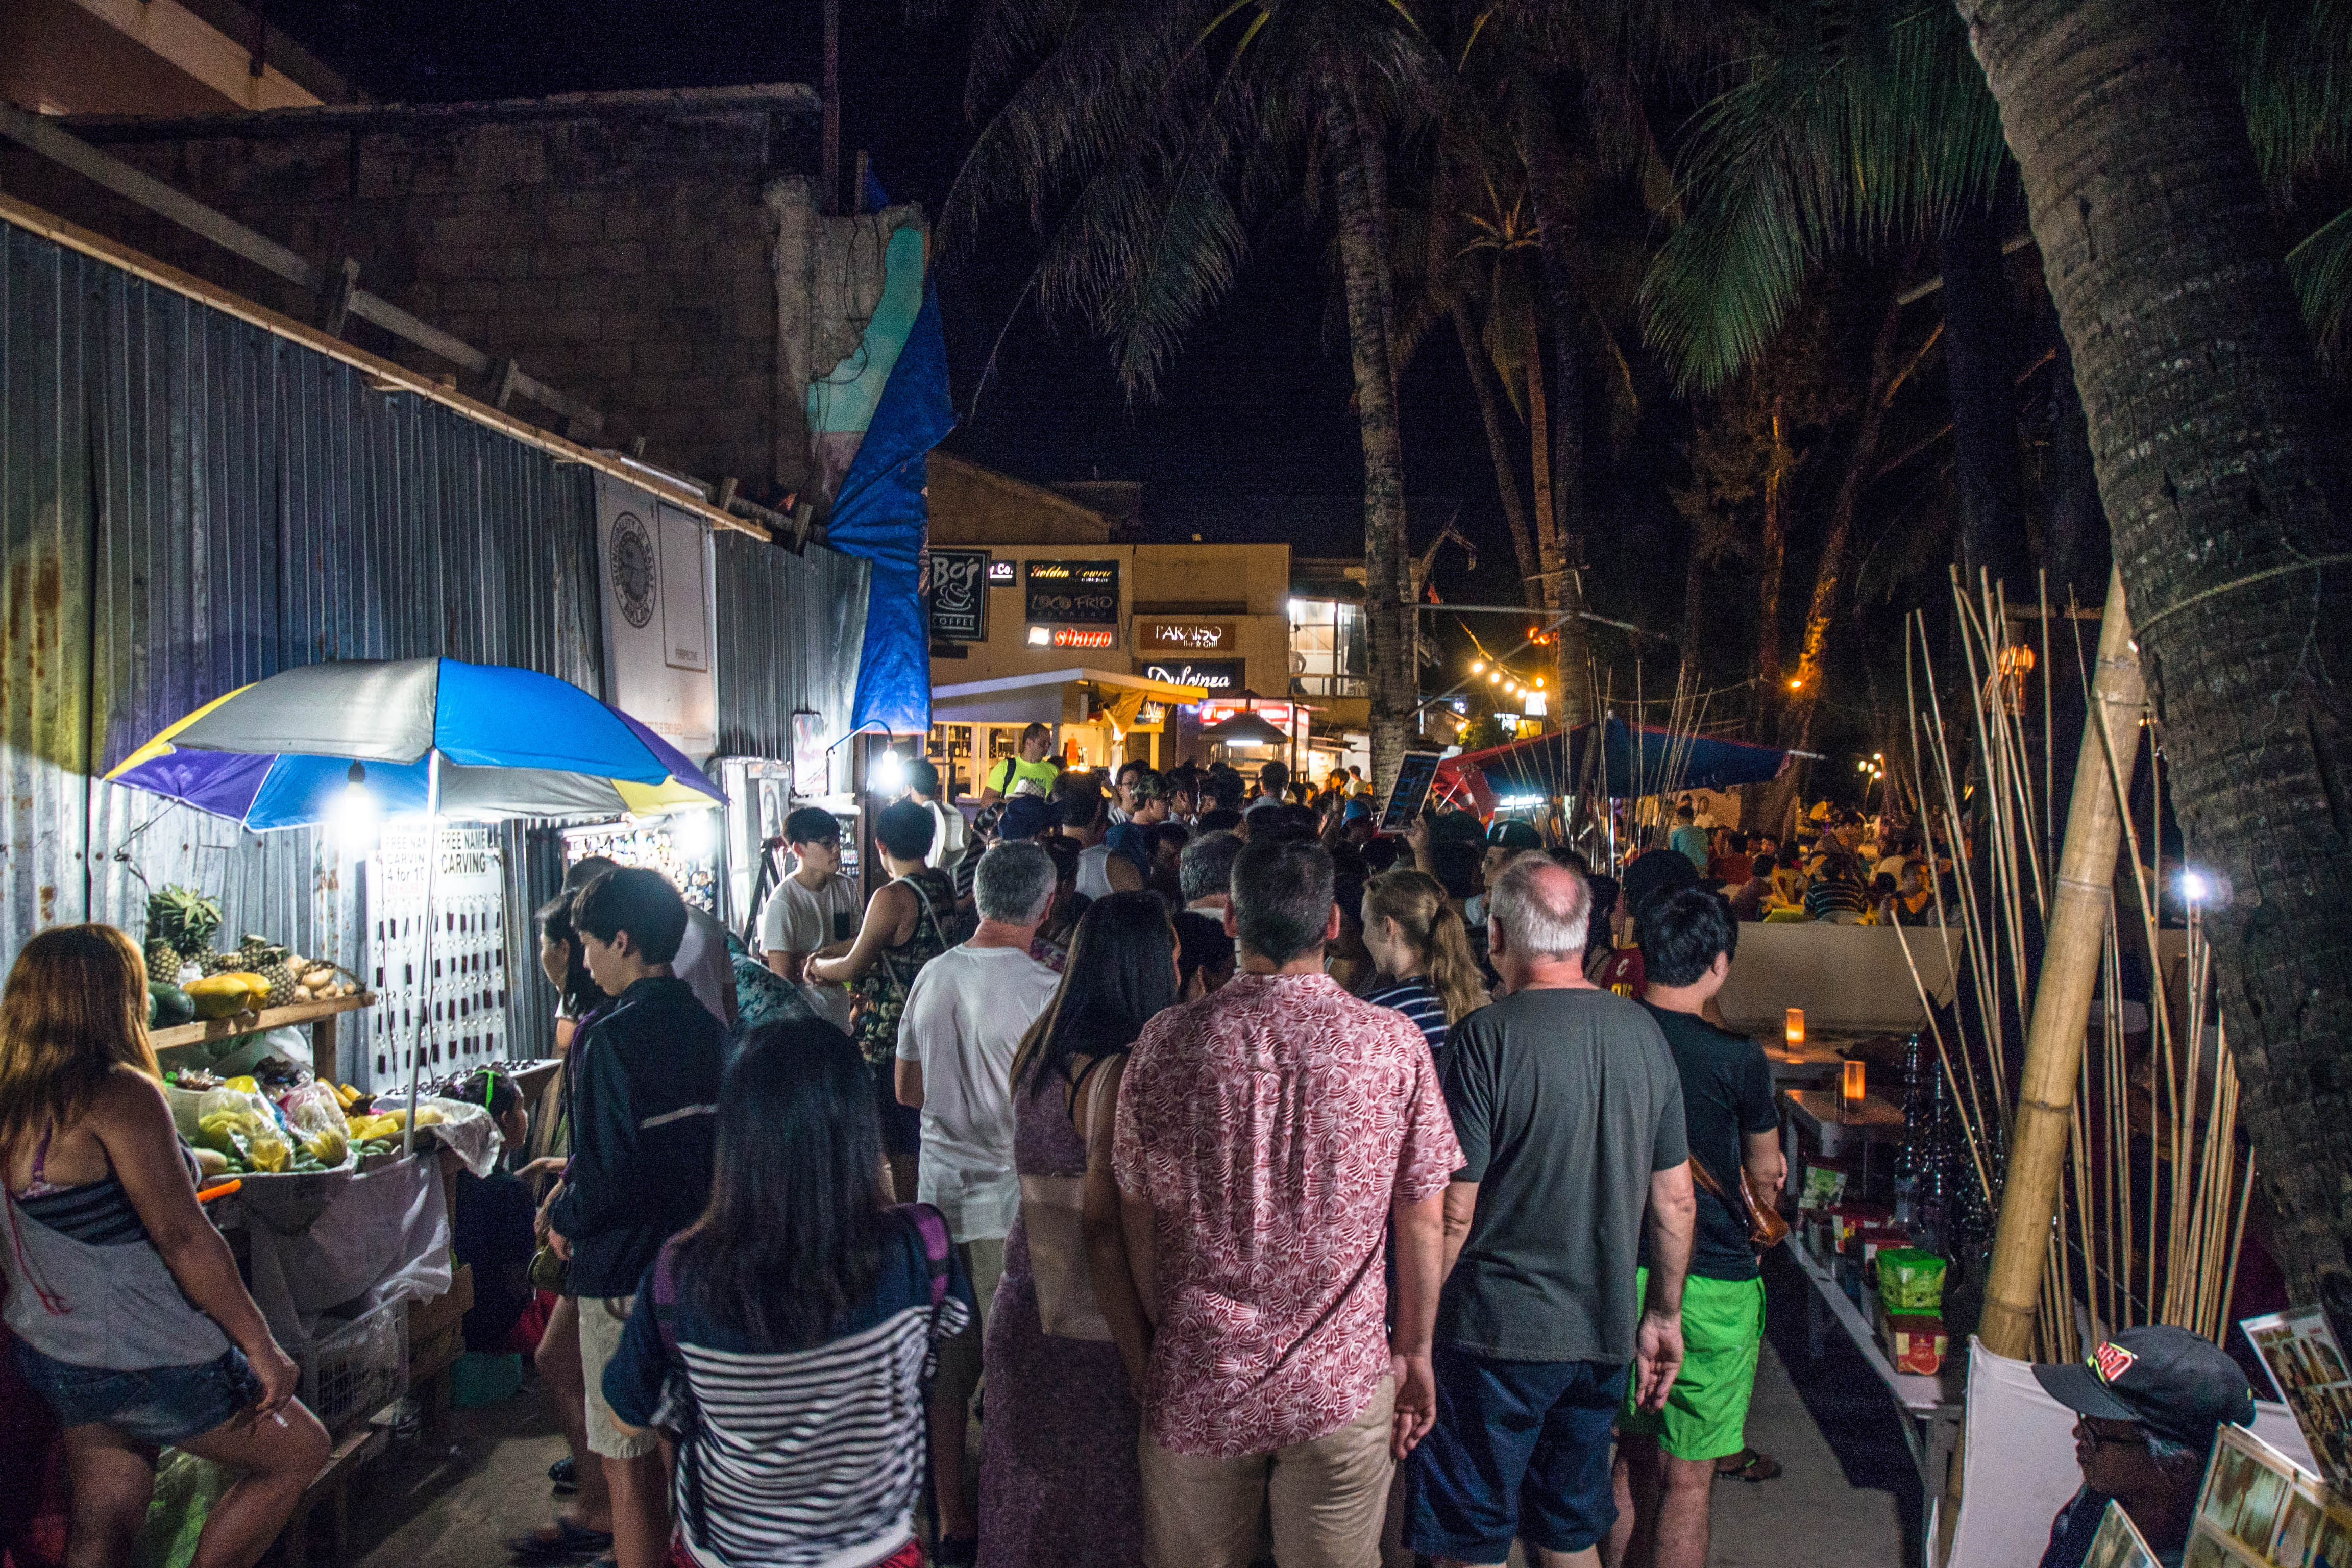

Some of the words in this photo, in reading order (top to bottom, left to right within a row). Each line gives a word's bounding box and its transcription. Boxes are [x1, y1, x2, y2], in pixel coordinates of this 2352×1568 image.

[1074, 594, 1113, 609] FRIO
[932, 617, 974, 626] COFFEE
[1055, 627, 1112, 647] sbarro
[441, 831, 461, 850] FREE
[464, 830, 485, 849] NAME
[387, 853, 425, 865] CARVIN
[441, 852, 486, 874] CARVING
